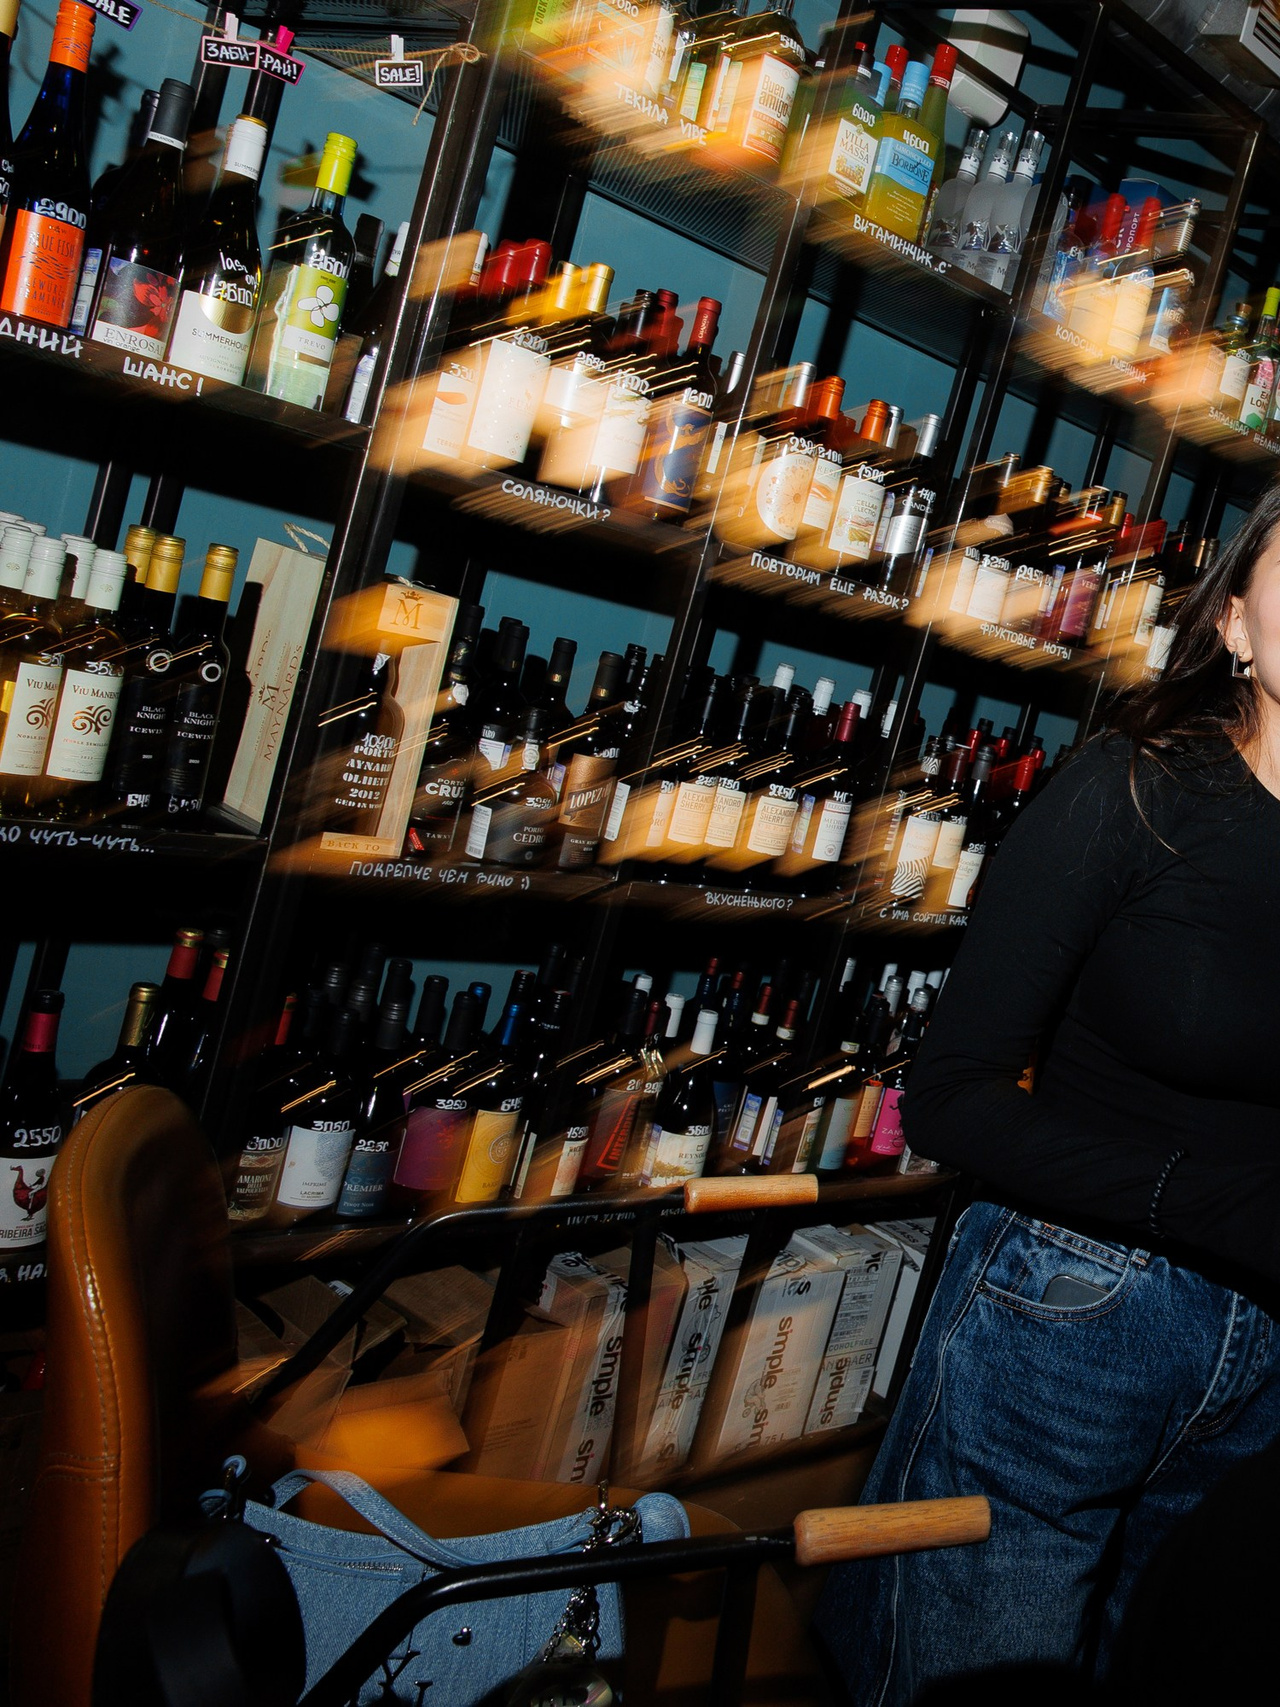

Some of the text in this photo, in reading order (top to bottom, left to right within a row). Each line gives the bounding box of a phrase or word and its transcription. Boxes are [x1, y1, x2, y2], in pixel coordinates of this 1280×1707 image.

[207, 42, 298, 80] ЗАБИ- -РАЙ!
[379, 63, 421, 83] SALE!
[761, 75, 785, 100] Buen
[614, 82, 708, 146] ТЕКИЛА VIBE
[757, 94, 789, 118] amigo
[852, 103, 876, 128] 6000
[844, 129, 870, 151] VILLA
[903, 129, 930, 155] 4600
[838, 138, 870, 165] MASSA
[894, 143, 933, 168] LIMONCELLO
[890, 152, 930, 185] BORBONE
[35, 197, 88, 230] 2900
[57, 236, 76, 258] FISH
[852, 214, 934, 268] ВИТАМИНЧИК
[697, 311, 710, 341] CHANGYU
[102, 337, 141, 353] vin orange
[298, 336, 327, 352] TREVO
[122, 356, 204, 397] ШАНС!
[681, 385, 714, 409] 1600
[856, 463, 886, 483] 1500
[501, 479, 612, 523] СОЛЯНОЧКИ?
[750, 551, 821, 586] ПОВТОРИМ
[862, 585, 910, 612] РАЗОК?
[390, 598, 425, 630] M
[979, 622, 1072, 661] ФРУКТОВЫЕ НОТЫ
[26, 678, 43, 691] VIU
[72, 685, 90, 697] VIU
[142, 705, 166, 714] BLACK
[264, 644, 303, 761] MAYNARD'S
[183, 717, 216, 728] KNIGHT
[188, 710, 214, 720] BLACK
[17, 733, 38, 742] NOBLE
[353, 745, 396, 759] PORTO
[425, 782, 465, 799] CRUZ
[437, 777, 465, 787] PORTO
[348, 787, 381, 800] 2012
[570, 790, 601, 809] LOPEZ
[759, 812, 786, 826] SHERRY
[761, 804, 796, 819] ALEXANDRO
[327, 839, 381, 852] BACK TO
[349, 860, 433, 881] ПОКРЕПЧЕ
[438, 867, 468, 884] ЧЕМ
[476, 874, 514, 888] ВИНО
[704, 890, 795, 912] ВКУСНЕНЬКОГО?
[892, 907, 909, 921] УМА
[949, 916, 969, 927] КАК
[435, 1098, 468, 1111] 3250
[311, 1119, 351, 1132] 3050
[12, 1126, 62, 1148] 2550
[354, 1138, 390, 1153] 2250
[237, 1173, 272, 1185] AMARONE
[343, 1180, 383, 1193] PREMIER
[0, 1225, 33, 1239] RIBEIRA
[762, 1315, 794, 1390] simple
[589, 1335, 622, 1417] simple
[819, 1356, 850, 1426] simple
